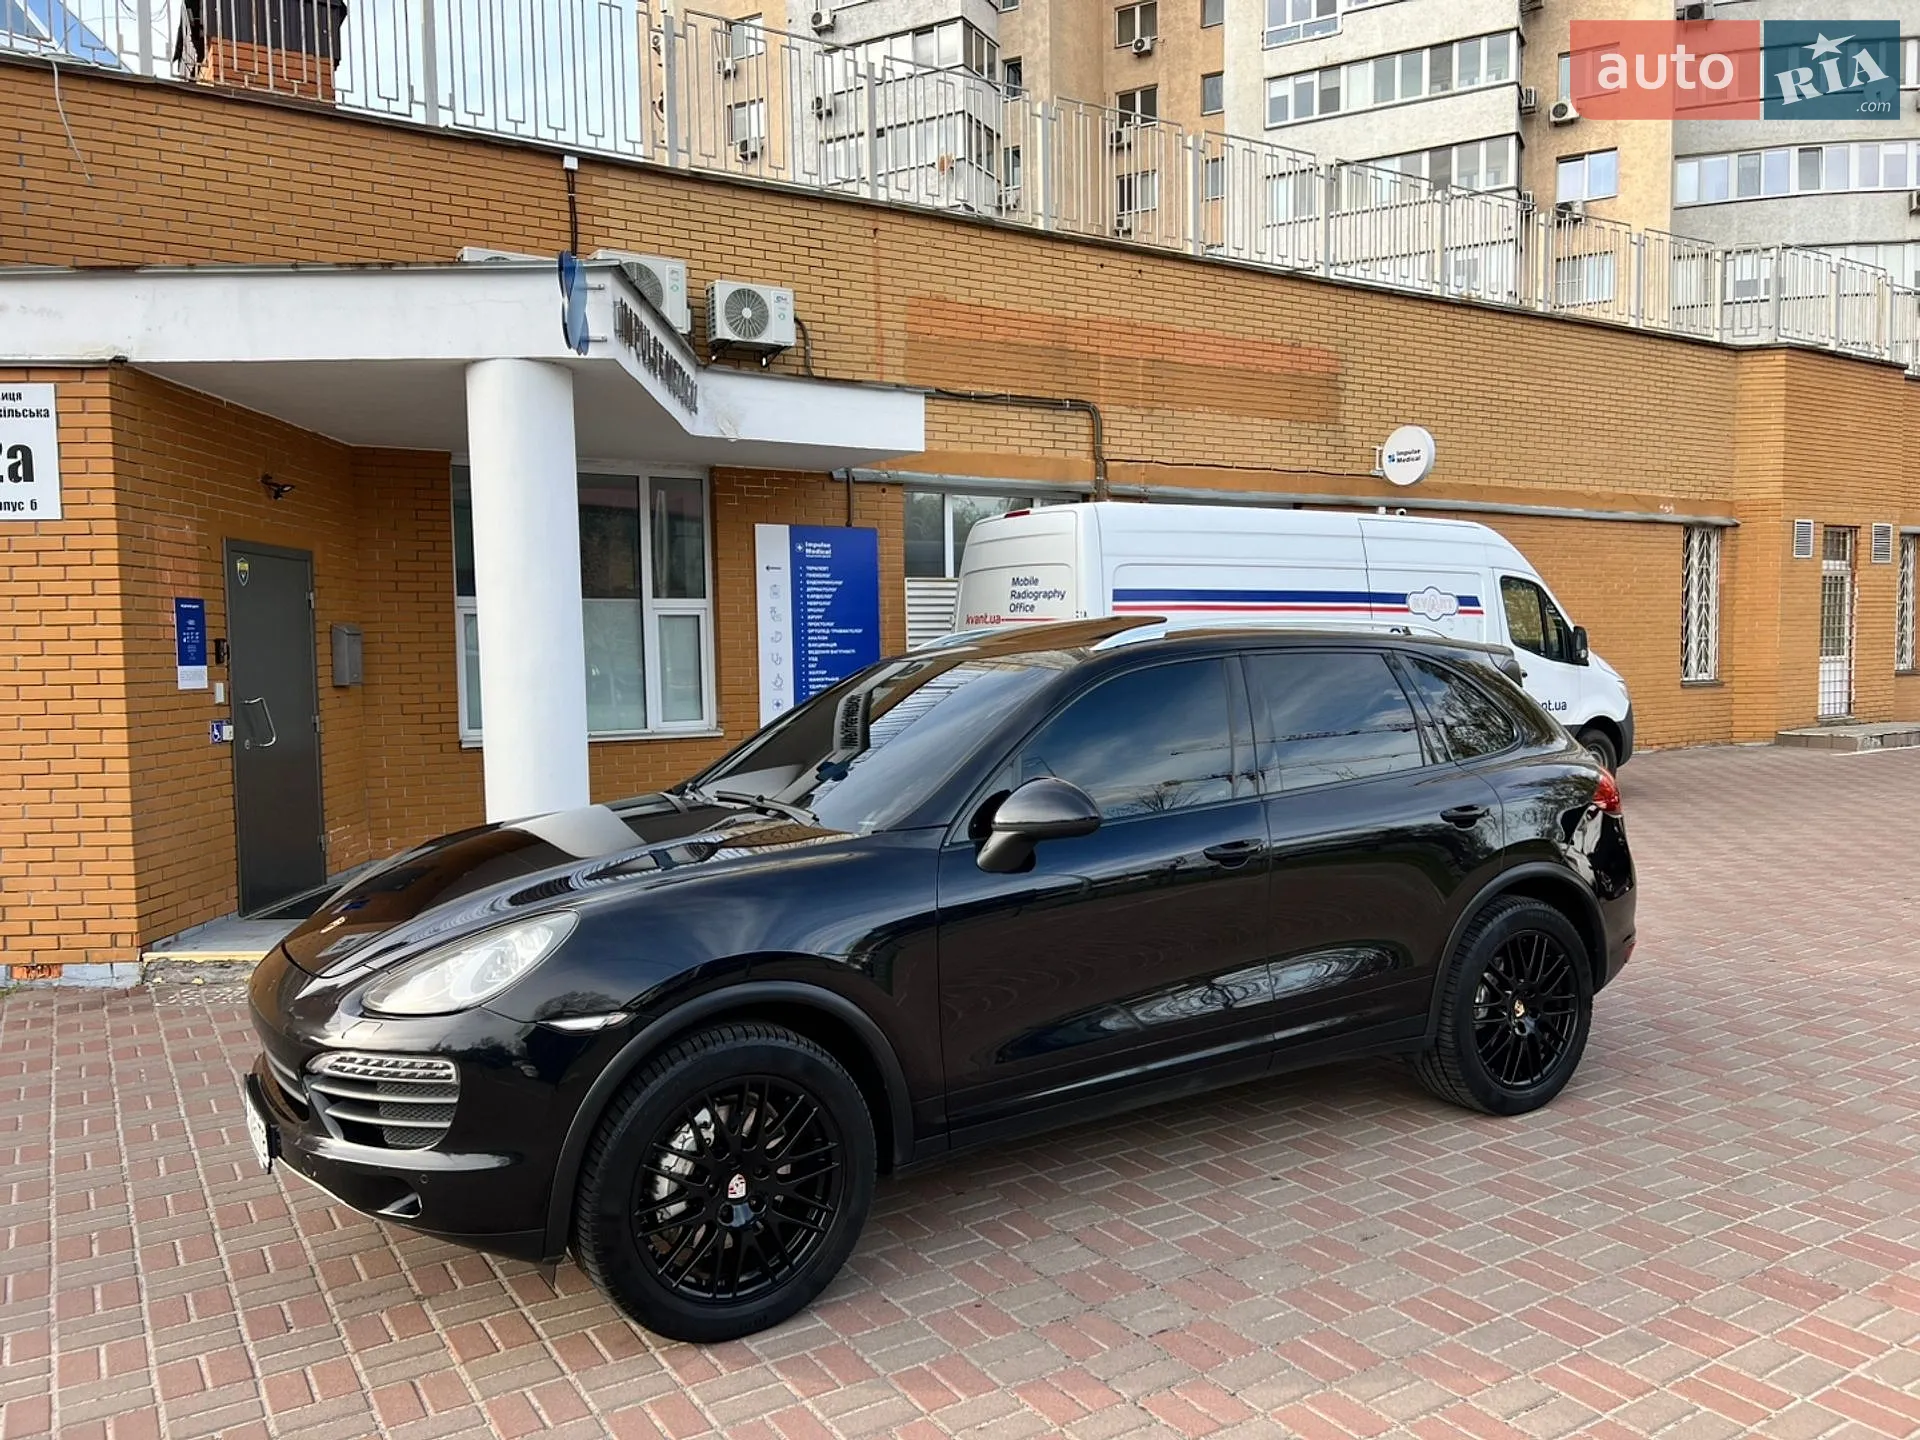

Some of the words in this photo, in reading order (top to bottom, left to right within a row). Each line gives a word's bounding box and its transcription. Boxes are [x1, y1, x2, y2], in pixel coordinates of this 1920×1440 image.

[1396, 455, 1421, 463] Medical
[30, 499, 38, 511] б
[805, 541, 831, 549] Impulse
[1011, 577, 1039, 586] Mobile
[1010, 589, 1066, 600] Radiography
[1009, 602, 1035, 613] Office
